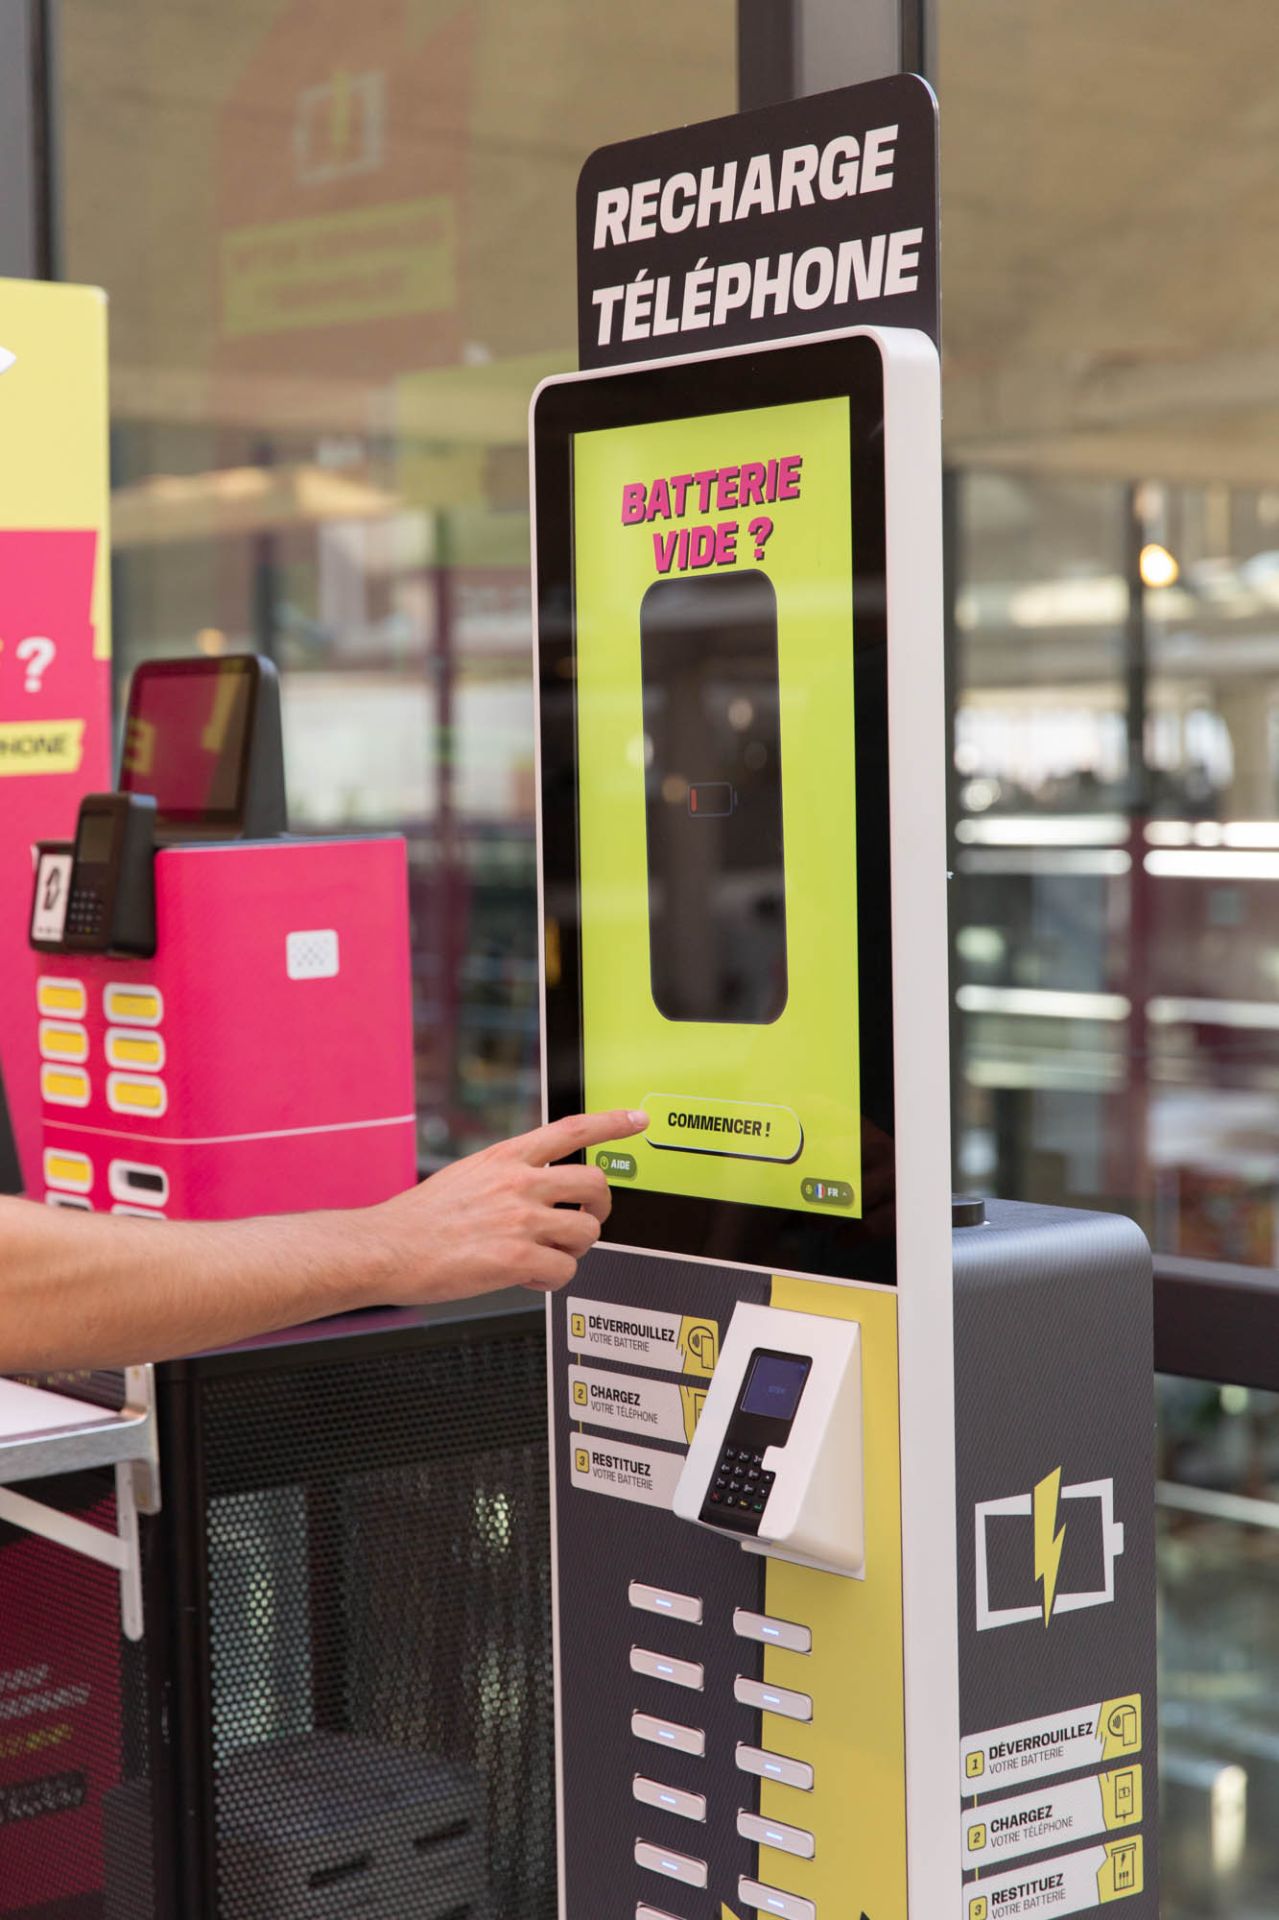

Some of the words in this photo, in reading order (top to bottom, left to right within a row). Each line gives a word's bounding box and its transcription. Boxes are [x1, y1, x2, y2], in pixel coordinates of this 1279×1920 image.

[593, 124, 899, 250] RECHARGE
[592, 227, 924, 346] TÉLÉPHONE
[621, 455, 803, 526] BATTERIE
[653, 520, 739, 575] VIDE
[748, 516, 774, 561] ?
[16, 636, 56, 692] ?
[667, 1111, 762, 1137] COMMENCER
[611, 1159, 631, 1171] AIDE
[827, 1187, 839, 1198] FR
[589, 1314, 675, 1342] DÉVERROUILLEZ
[589, 1332, 611, 1347] VOTRE
[614, 1337, 649, 1352] BATTERIE
[591, 1384, 640, 1406] CHARGEZ
[591, 1400, 614, 1415] VOTRE
[617, 1404, 658, 1424] TÉLÉPHONE
[593, 1452, 651, 1476] RESTITUEZ
[593, 1468, 616, 1483] VOTRE
[618, 1472, 653, 1490] BATTERIE
[989, 1721, 1093, 1760] DÉVERROUILLEZ
[989, 1758, 1018, 1775] VOTRE
[1021, 1746, 1064, 1765] BATTERIE
[991, 1805, 1052, 1833] CHARGEZ
[991, 1831, 1020, 1848] VOTRE
[1024, 1816, 1073, 1838] TÉLÉPHONE
[992, 1873, 1063, 1905] RESTITUEZ
[992, 1902, 1020, 1919] VOTRE
[1024, 1889, 1065, 1910] BATTERIE
